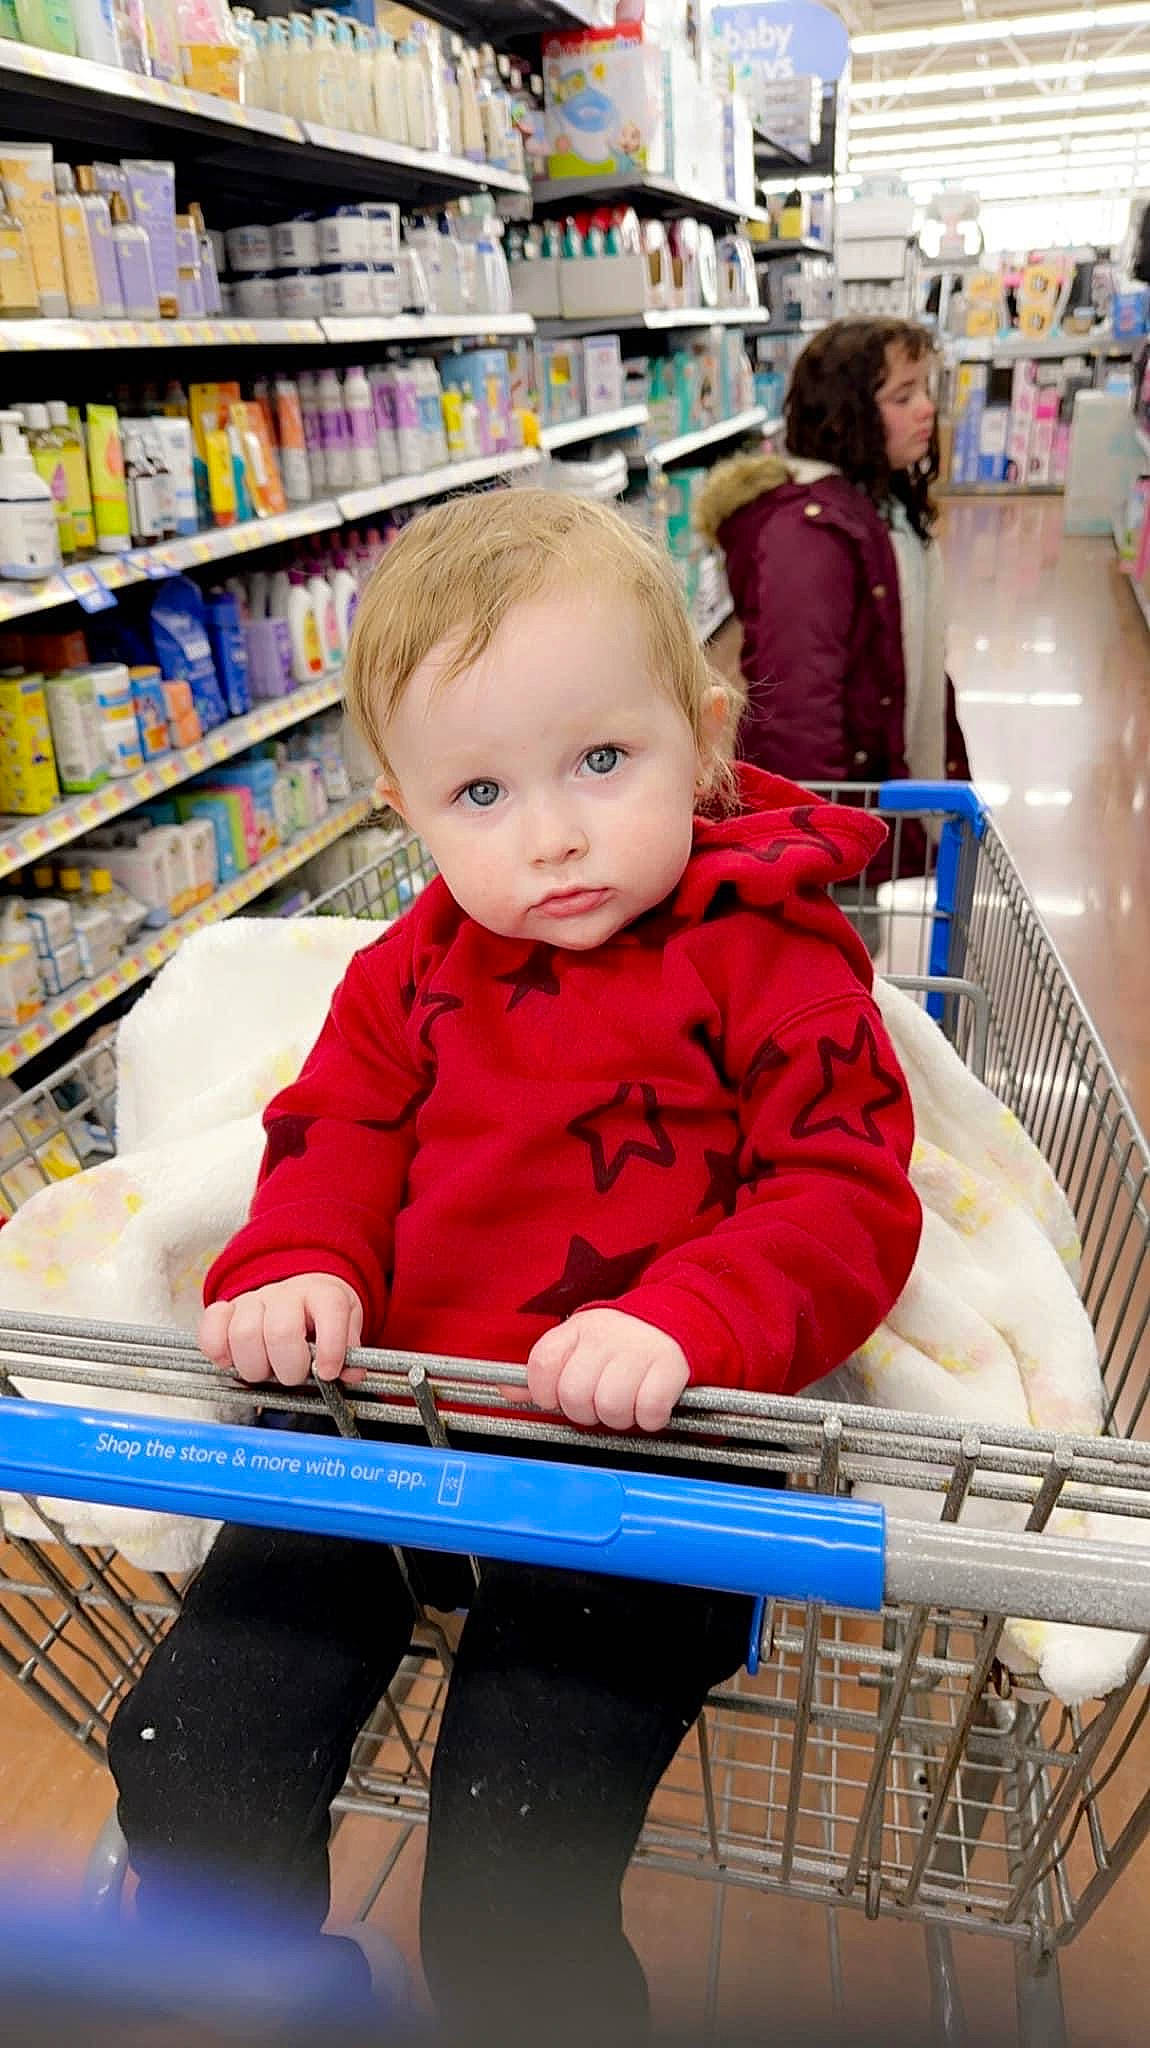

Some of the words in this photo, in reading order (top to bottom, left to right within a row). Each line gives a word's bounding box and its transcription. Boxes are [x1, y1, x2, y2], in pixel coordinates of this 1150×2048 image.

[96, 1432, 141, 1459] Shop
[145, 1439, 176, 1459] the
[179, 1444, 228, 1465] store
[231, 1447, 246, 1468] &
[250, 1454, 301, 1473] more
[305, 1457, 346, 1478] with
[350, 1464, 384, 1482] our
[387, 1468, 426, 1491] app.
